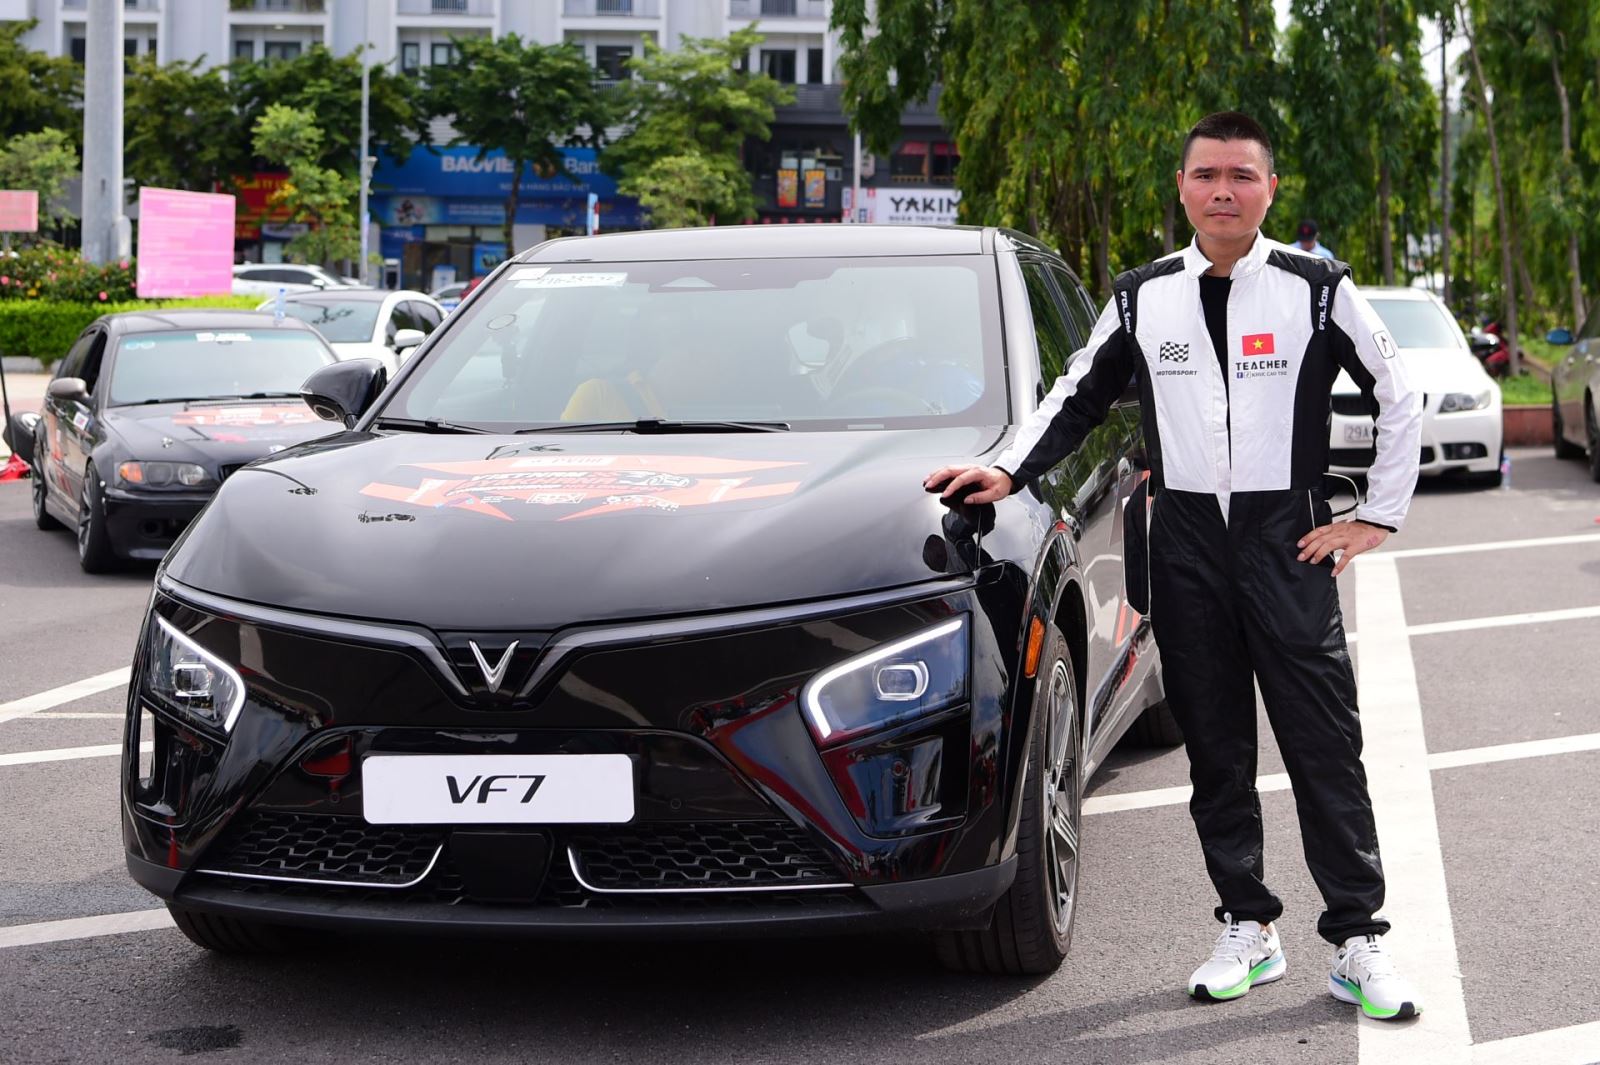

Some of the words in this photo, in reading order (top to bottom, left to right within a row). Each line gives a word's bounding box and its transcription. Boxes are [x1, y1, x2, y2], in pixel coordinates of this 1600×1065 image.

[441, 155, 516, 172] BAOVIE
[565, 158, 600, 175] Ban
[1120, 290, 1131, 334] VOLSON
[1318, 285, 1330, 331] VOLSON
[1235, 359, 1288, 371] TEACHER
[446, 775, 547, 804] VF7
